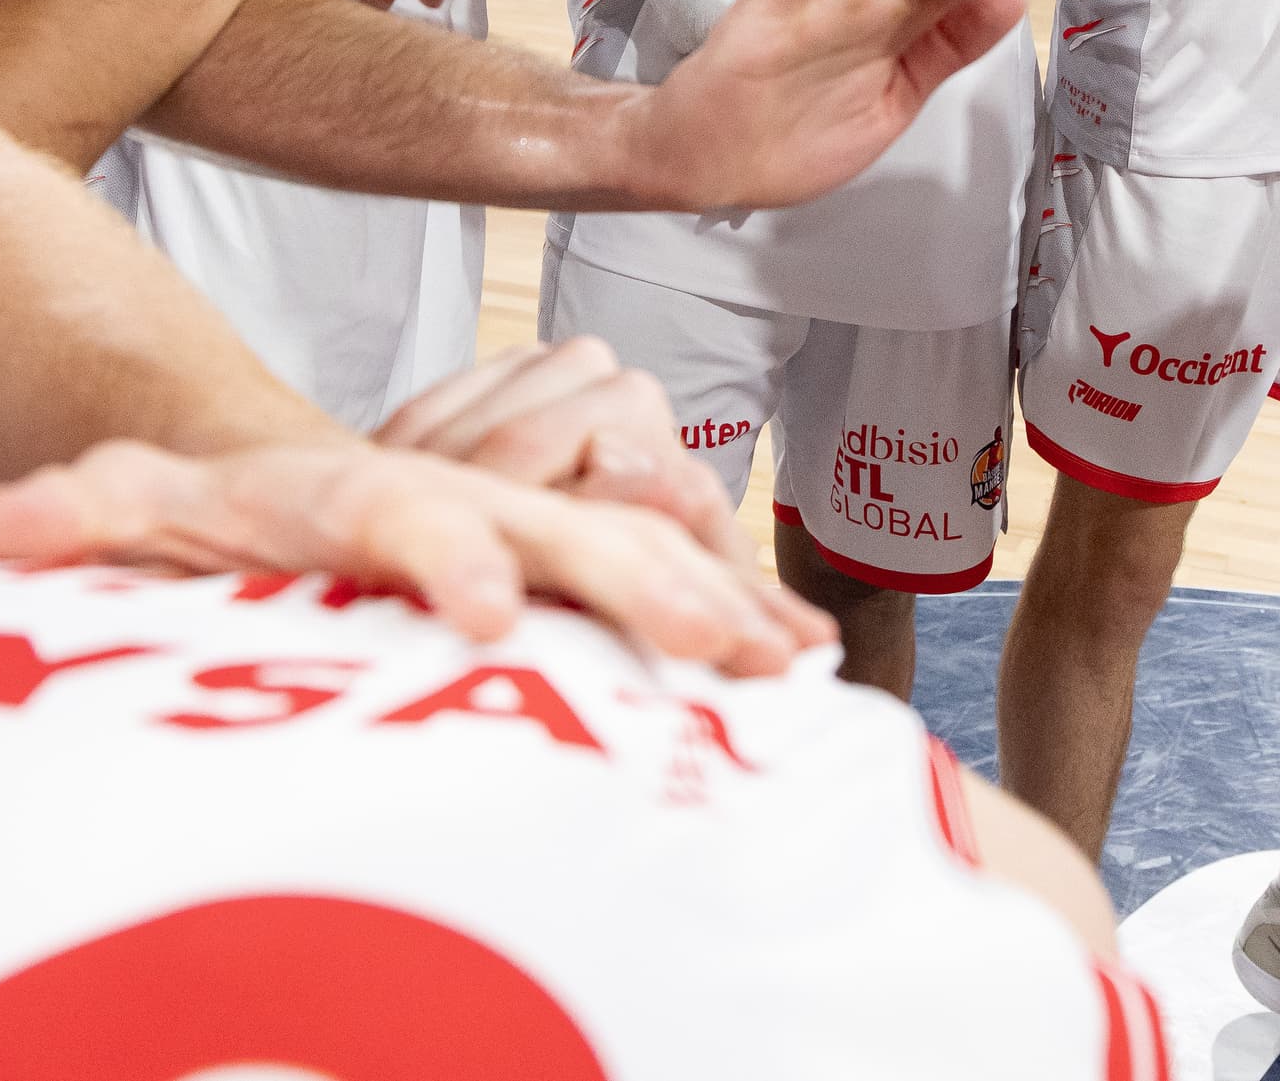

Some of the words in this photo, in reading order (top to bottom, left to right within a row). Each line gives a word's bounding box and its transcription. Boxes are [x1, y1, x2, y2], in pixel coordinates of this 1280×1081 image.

[1129, 343, 1267, 386] Occident
[842, 424, 959, 465] dbisio
[830, 483, 963, 541] GLOBAL
